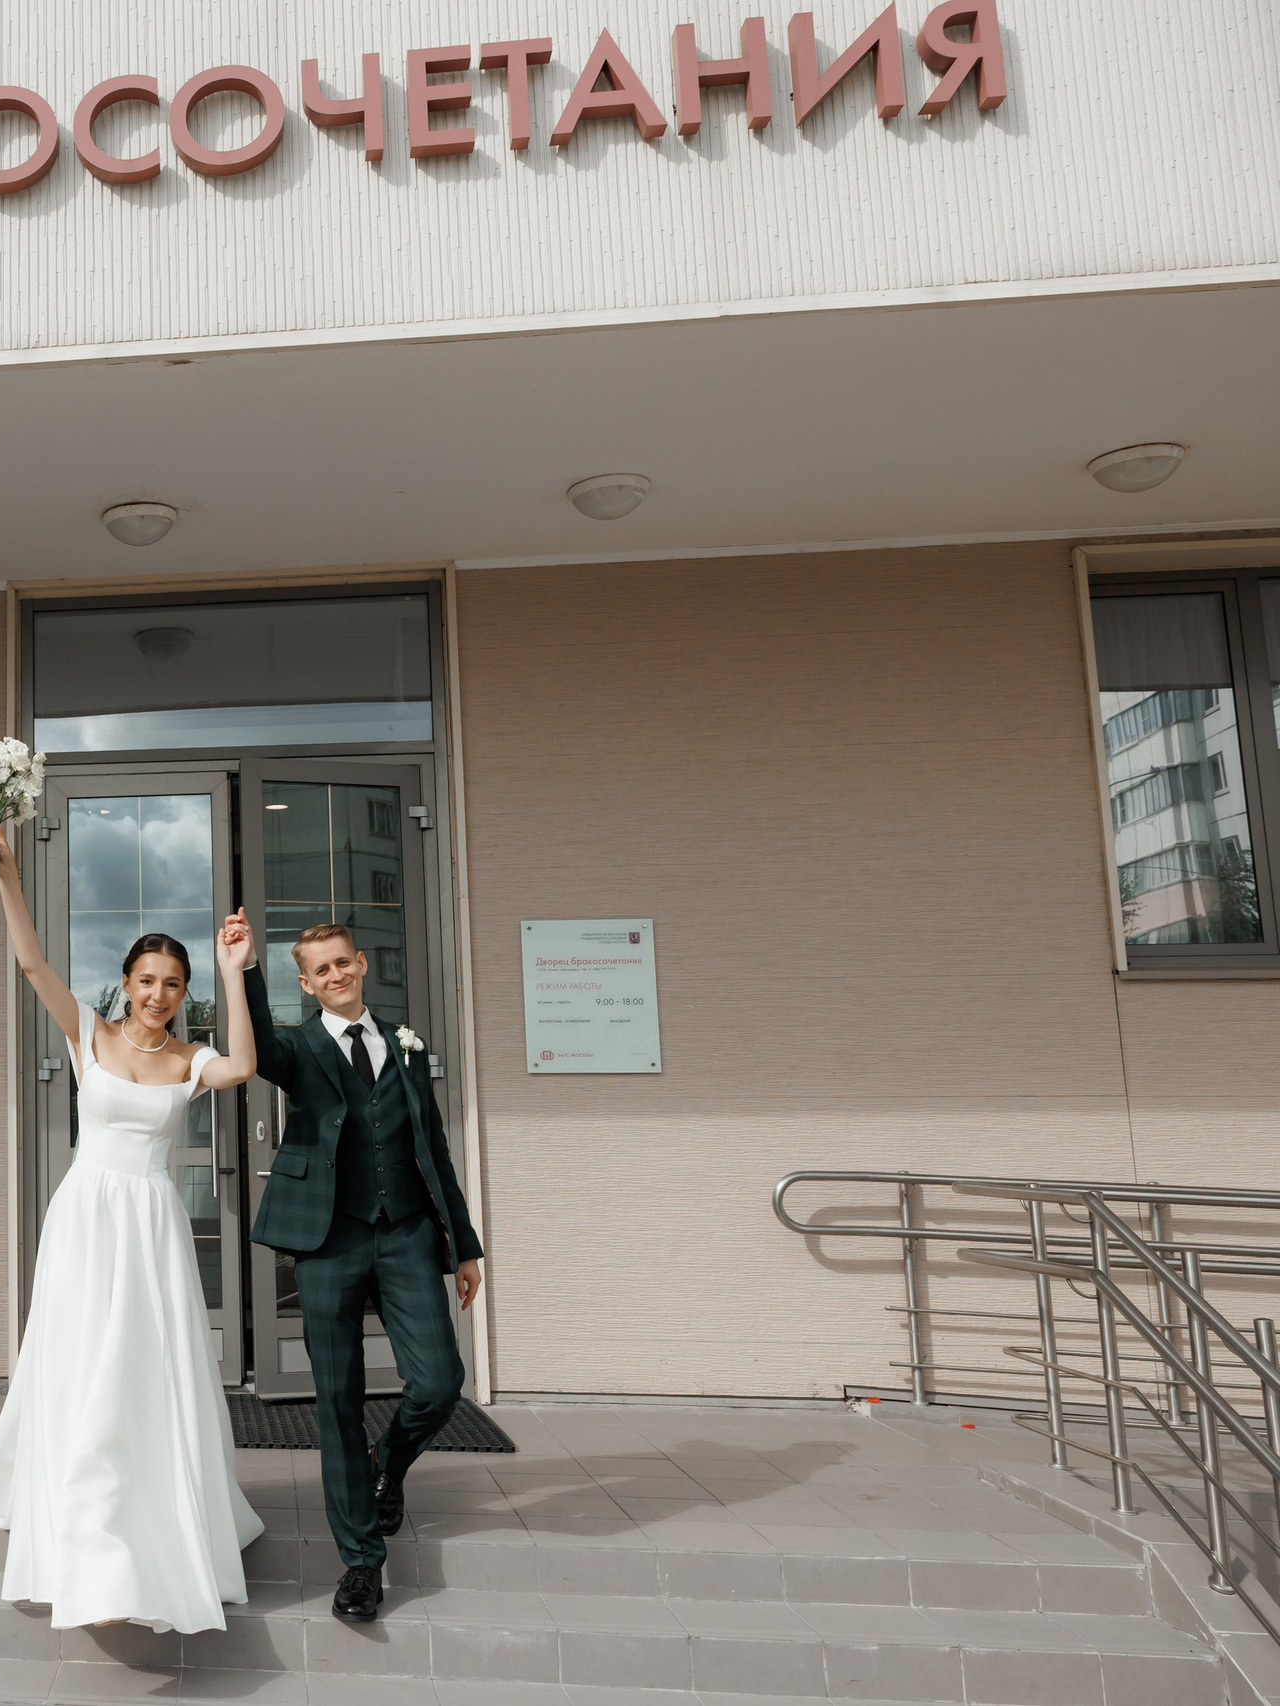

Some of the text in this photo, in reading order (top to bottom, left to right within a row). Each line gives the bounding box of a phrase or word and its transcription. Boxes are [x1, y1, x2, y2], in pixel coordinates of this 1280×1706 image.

[536, 957, 642, 967] Дворец бракосочетания
[596, 998, 614, 1006] 9:00
[622, 997, 644, 1006] 18:00
